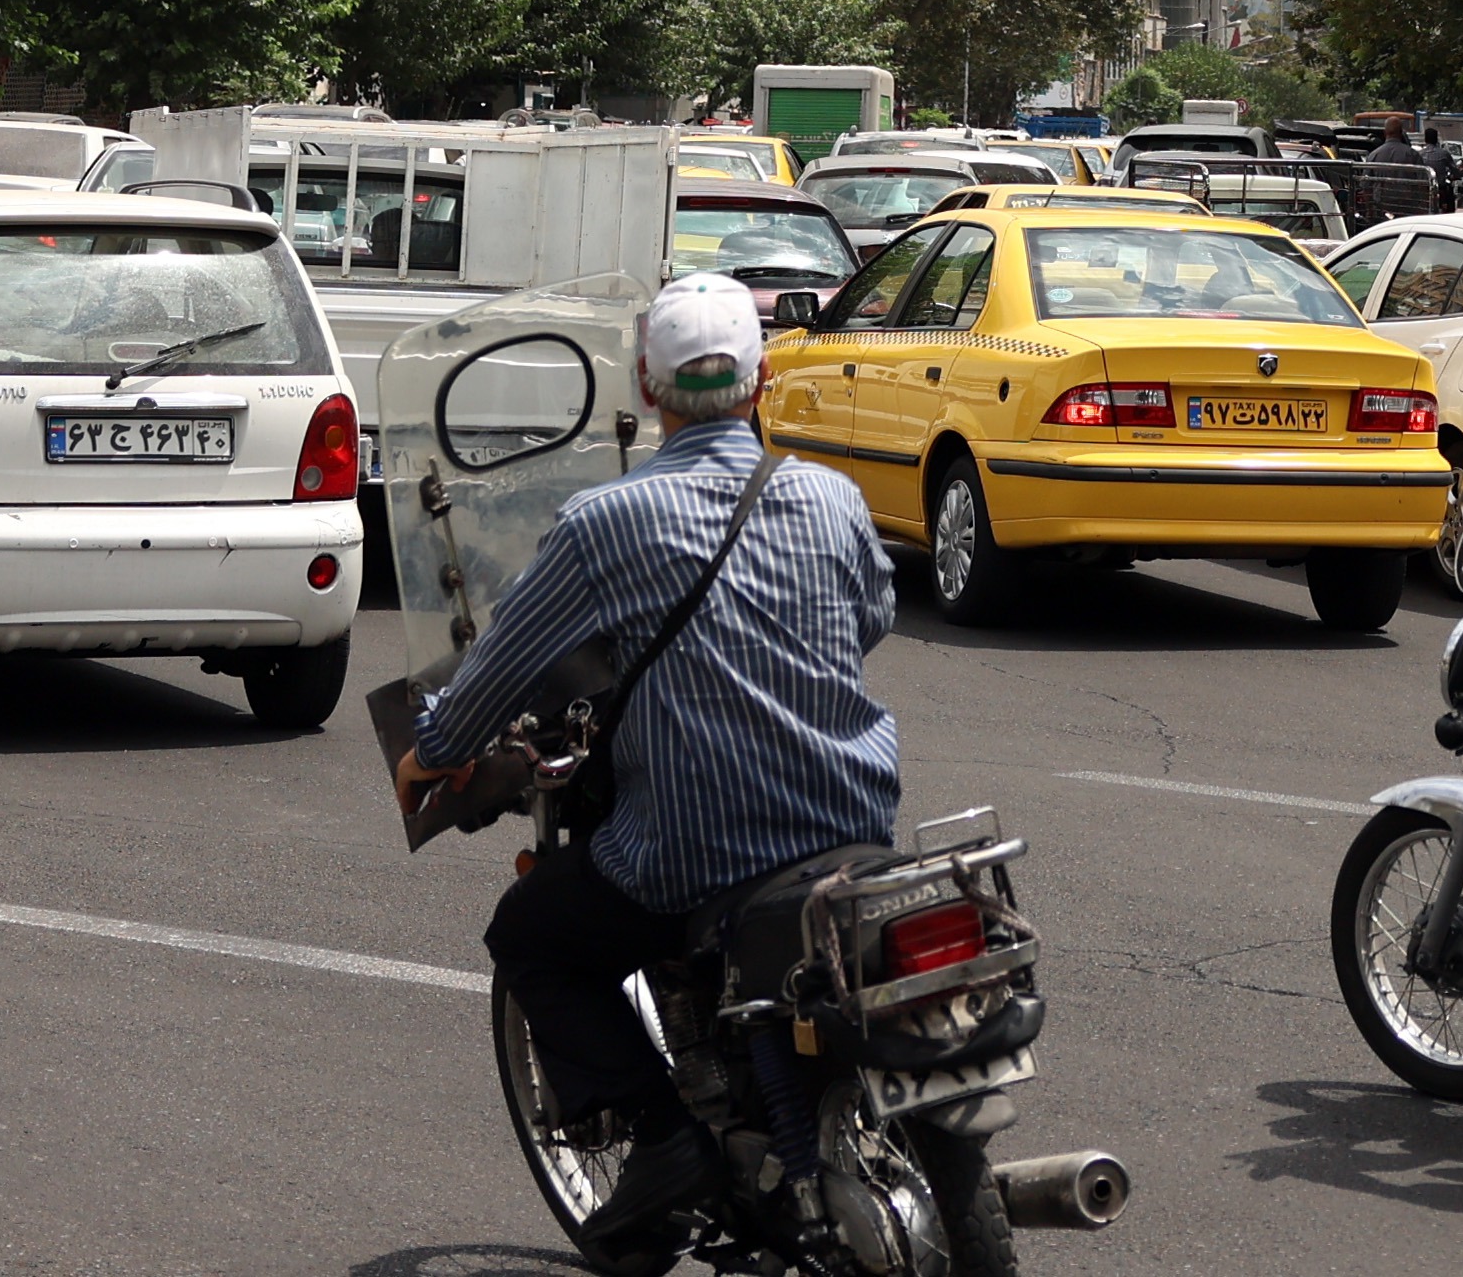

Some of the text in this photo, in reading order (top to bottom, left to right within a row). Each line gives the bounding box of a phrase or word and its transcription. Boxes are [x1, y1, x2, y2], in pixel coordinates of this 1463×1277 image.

[1204, 402, 1324, 429] ۹۷ ت ۵۹۸ ۲۲
[1233, 402, 1255, 411] TAXI
[69, 423, 225, 454] ۶۳ ج ۴۶۳ ۴۰
[850, 882, 939, 922] ONDA
